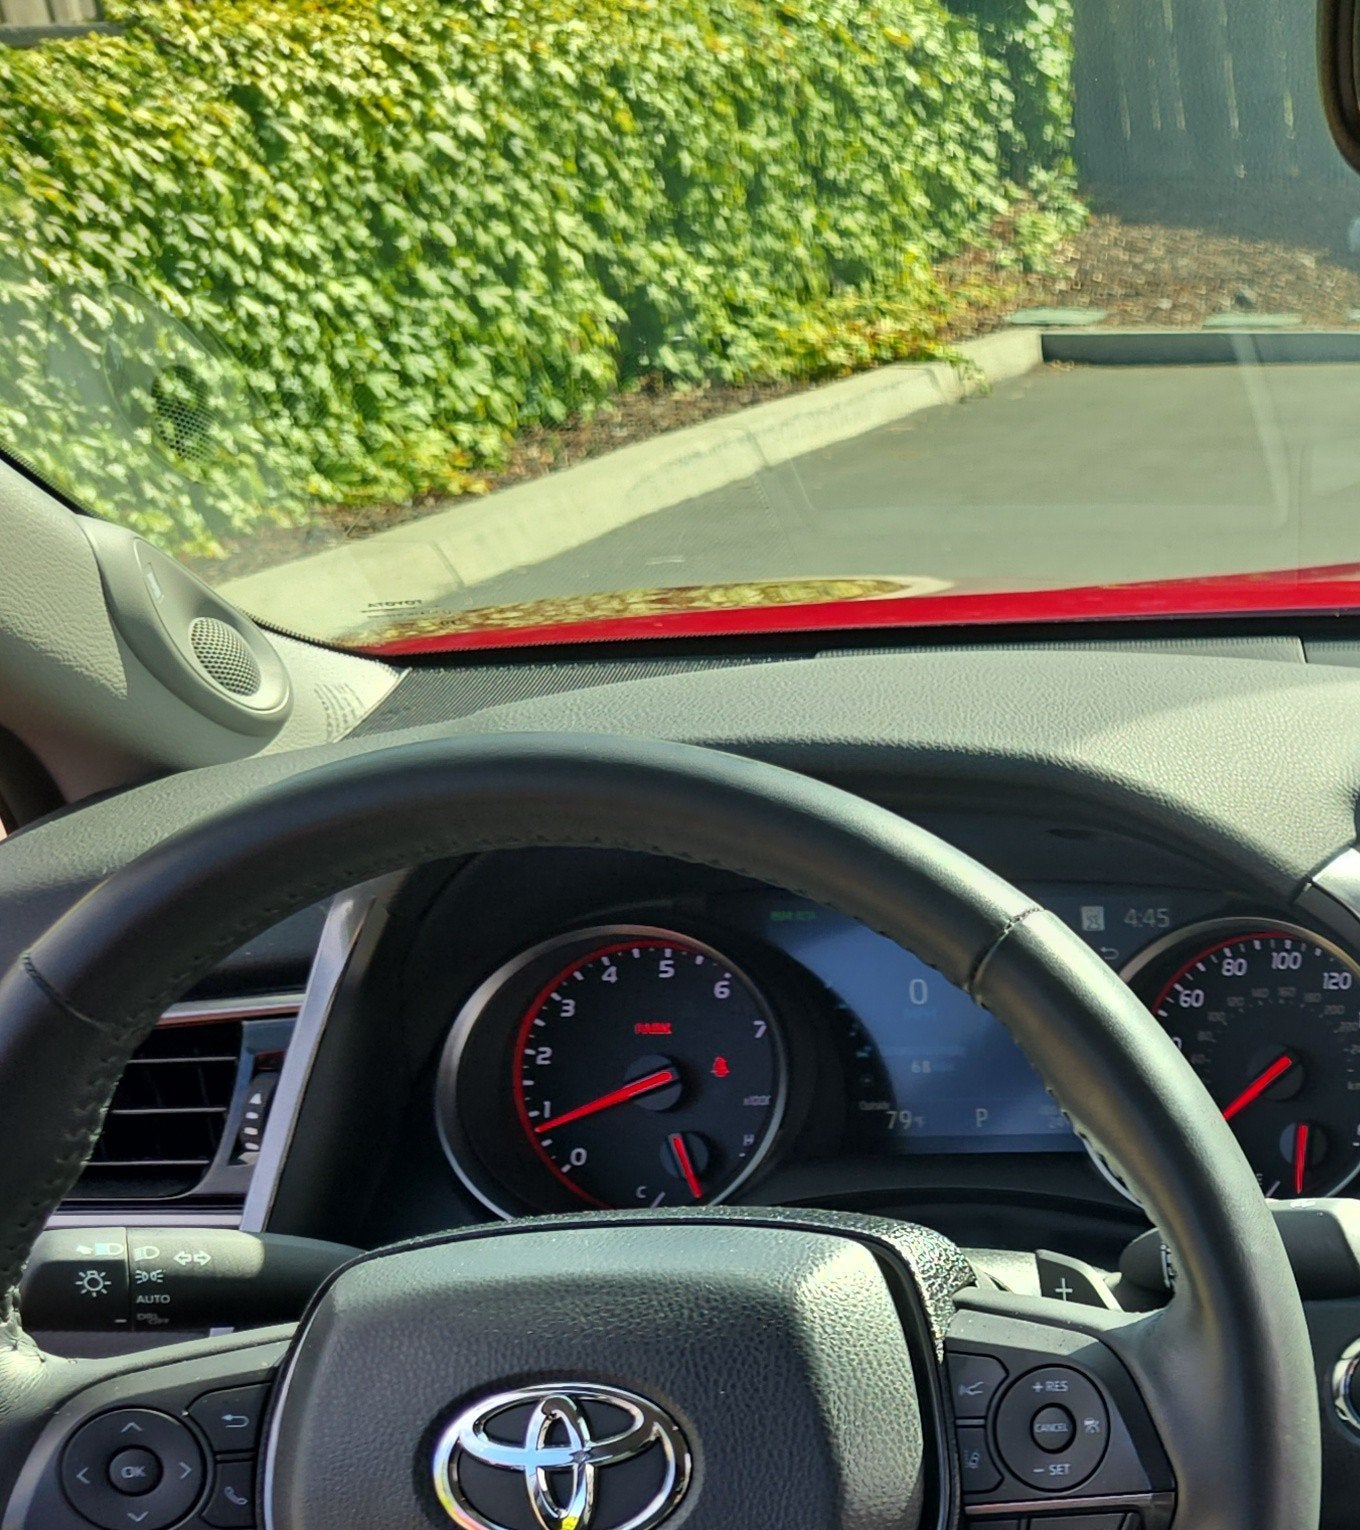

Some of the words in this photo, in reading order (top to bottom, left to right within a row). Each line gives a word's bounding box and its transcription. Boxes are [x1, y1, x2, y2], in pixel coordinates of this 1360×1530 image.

[1124, 907, 1171, 930] 4:45
[658, 960, 674, 978] 5
[1222, 958, 1248, 976] 80
[1271, 952, 1302, 970] 100
[602, 966, 618, 983] 4
[1322, 972, 1352, 990] 120
[713, 981, 731, 999] 6
[1179, 989, 1204, 1008] 60
[560, 1000, 576, 1017] 3
[753, 1020, 768, 1039] 7
[535, 1047, 552, 1065] 2
[570, 1148, 587, 1166] 0
[636, 1185, 646, 1199] C
[136, 1294, 171, 1304] AUTO
[1035, 1422, 1068, 1432] CANCEL
[120, 1464, 147, 1479] OK
